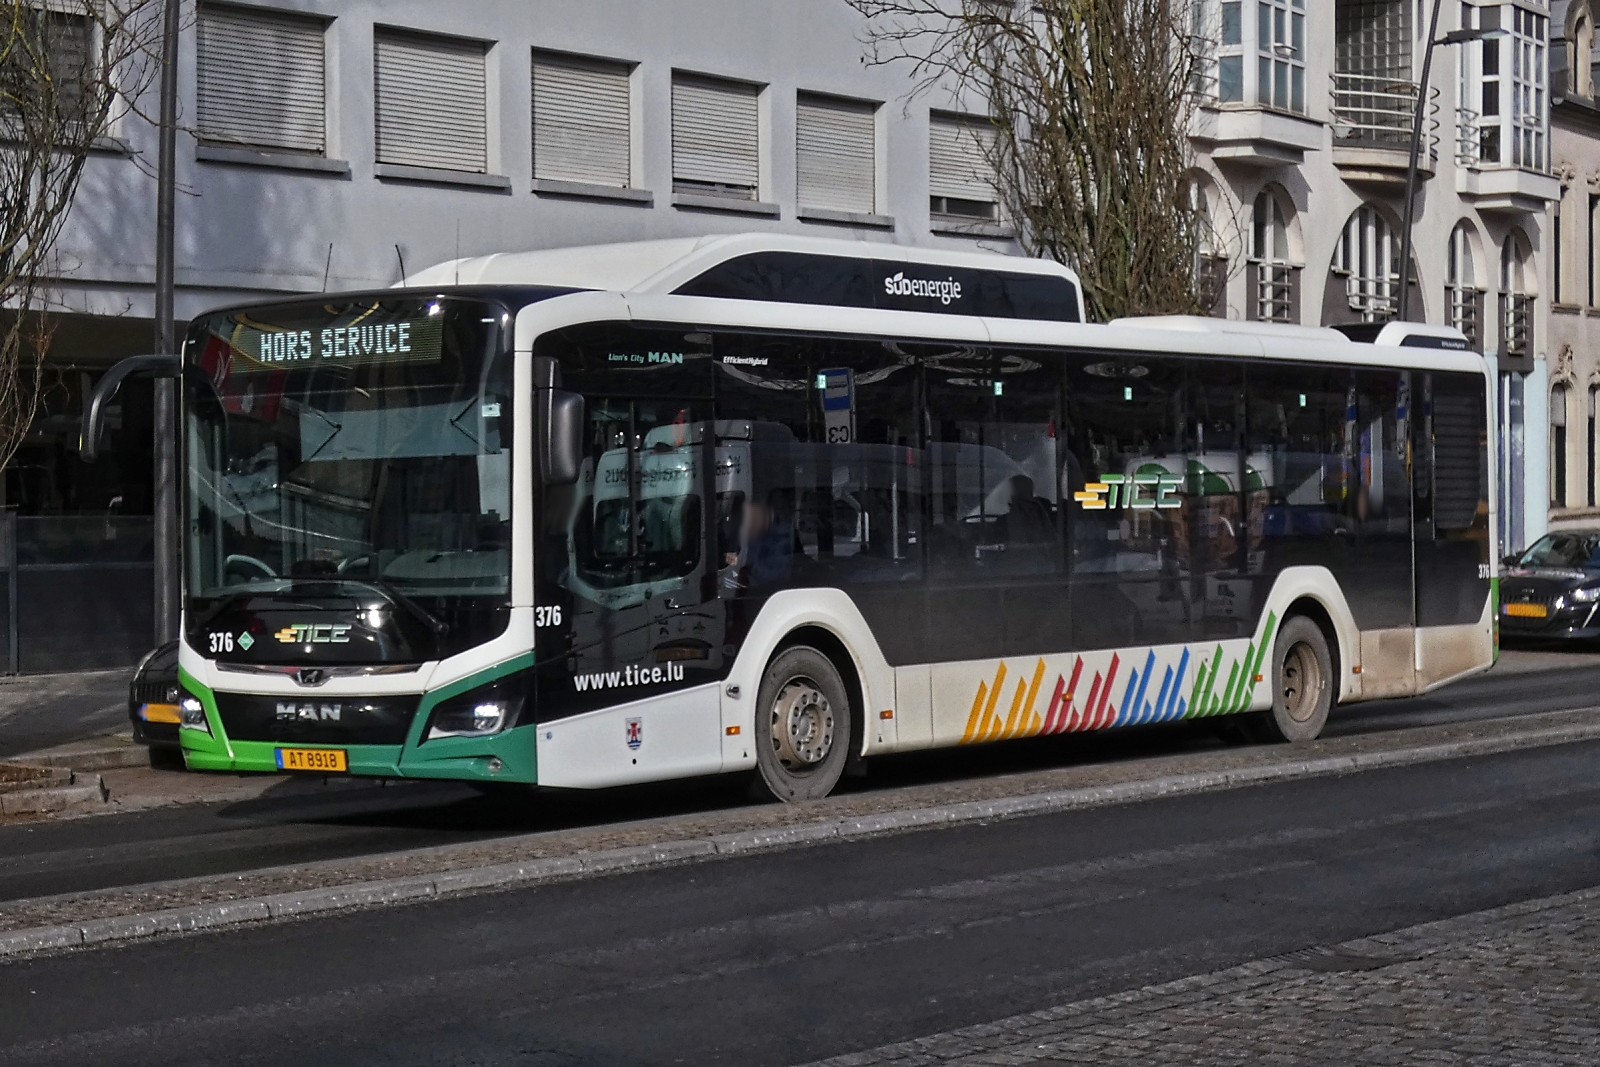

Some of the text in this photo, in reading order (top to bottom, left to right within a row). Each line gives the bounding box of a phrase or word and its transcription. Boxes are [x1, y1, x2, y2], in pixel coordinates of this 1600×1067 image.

[260, 323, 412, 362] HORS SERVICE
[608, 351, 683, 364] Lion's City MAN
[1099, 473, 1185, 509] TICE
[1478, 563, 1490, 579] 376
[535, 605, 562, 627] 376
[209, 632, 234, 653] 376
[290, 624, 352, 643] TICE
[573, 661, 684, 692] www.tice.lu
[276, 703, 341, 721] MAN
[289, 752, 337, 768] AT 8918
